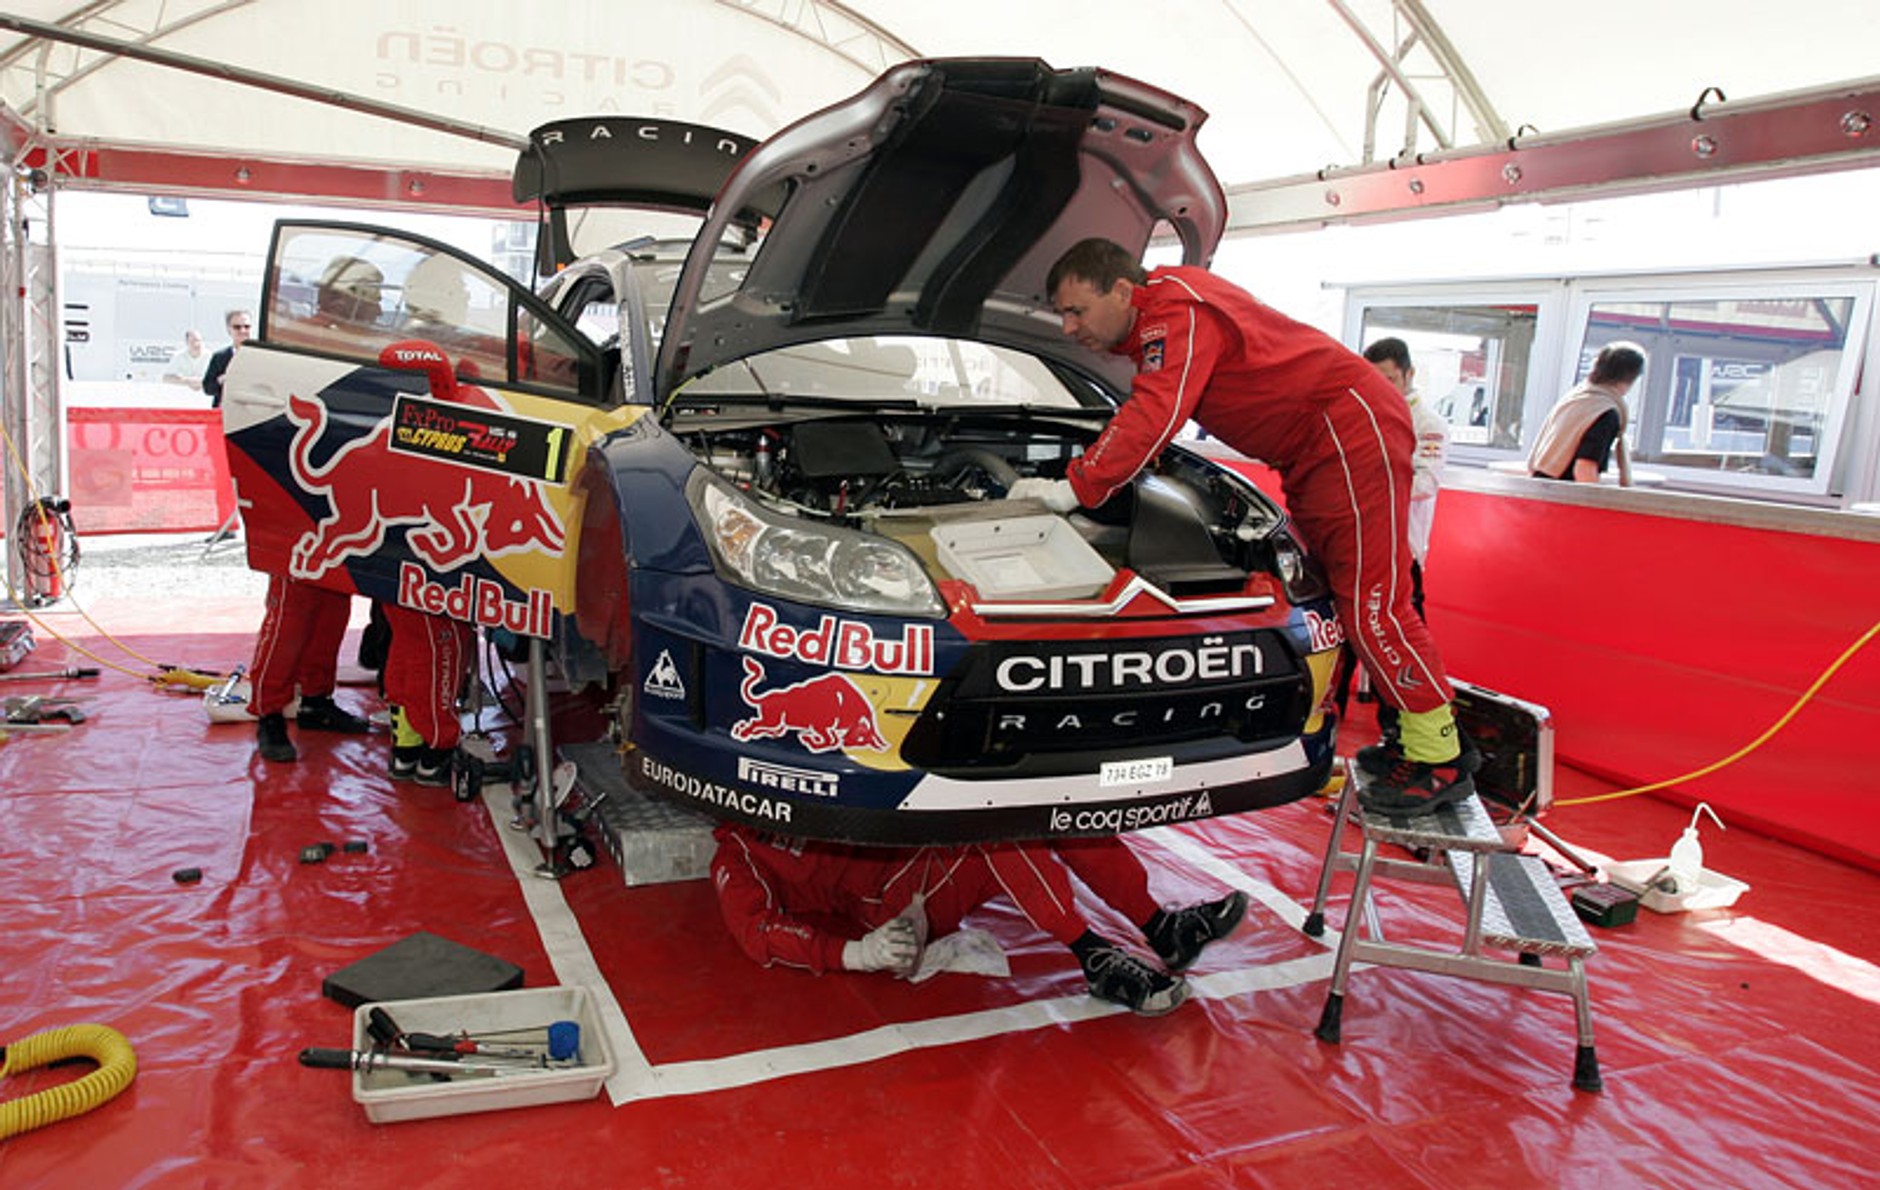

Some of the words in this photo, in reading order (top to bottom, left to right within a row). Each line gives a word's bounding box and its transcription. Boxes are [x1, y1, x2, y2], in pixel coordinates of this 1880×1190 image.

[395, 349, 444, 361] TOTAL
[402, 404, 456, 432] FxPro
[413, 427, 467, 454] CYPRUS
[545, 427, 563, 481] 1
[397, 560, 474, 622] Red
[475, 578, 554, 640] Bull
[738, 601, 837, 666] Red
[834, 619, 935, 676] Bull
[642, 756, 792, 822] EURODATACAR
[738, 757, 839, 797] PIRELLI
[1050, 806, 1073, 830] le
[1076, 808, 1122, 833] coq
[1124, 795, 1193, 829] sportif
